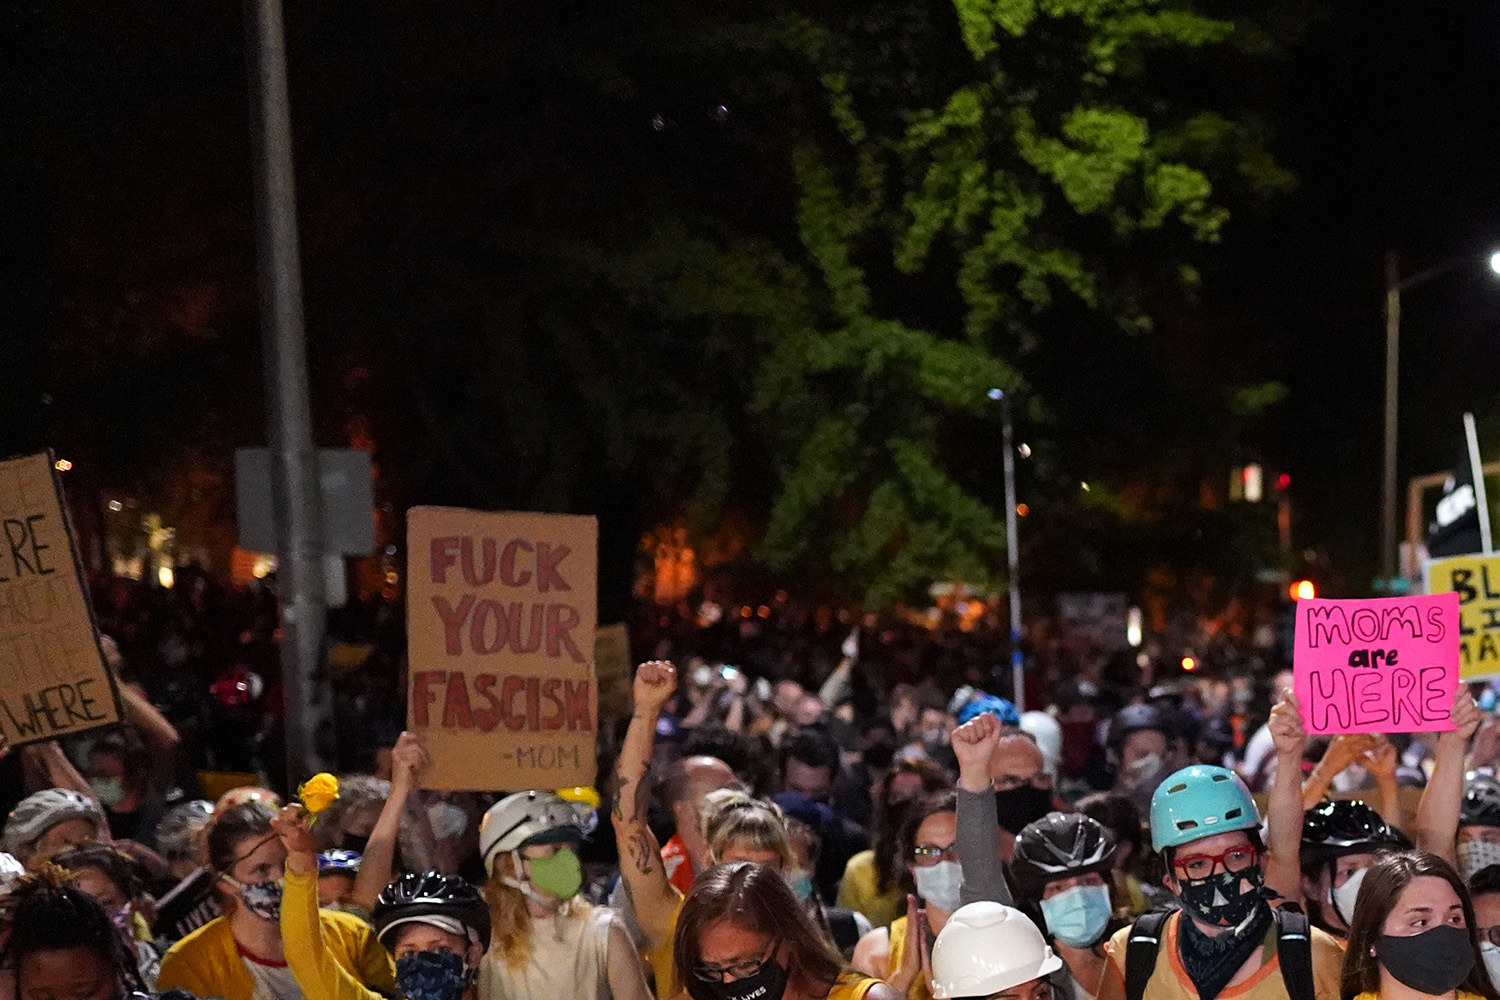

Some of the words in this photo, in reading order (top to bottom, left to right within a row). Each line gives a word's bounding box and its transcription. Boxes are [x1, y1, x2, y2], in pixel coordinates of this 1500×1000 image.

[430, 537, 572, 593] FUCK
[430, 594, 587, 664] YOUR
[1348, 648, 1399, 669] are
[413, 670, 594, 733] FASCISM
[1310, 666, 1451, 732] HERE
[741, 986, 766, 1000] LIVES
